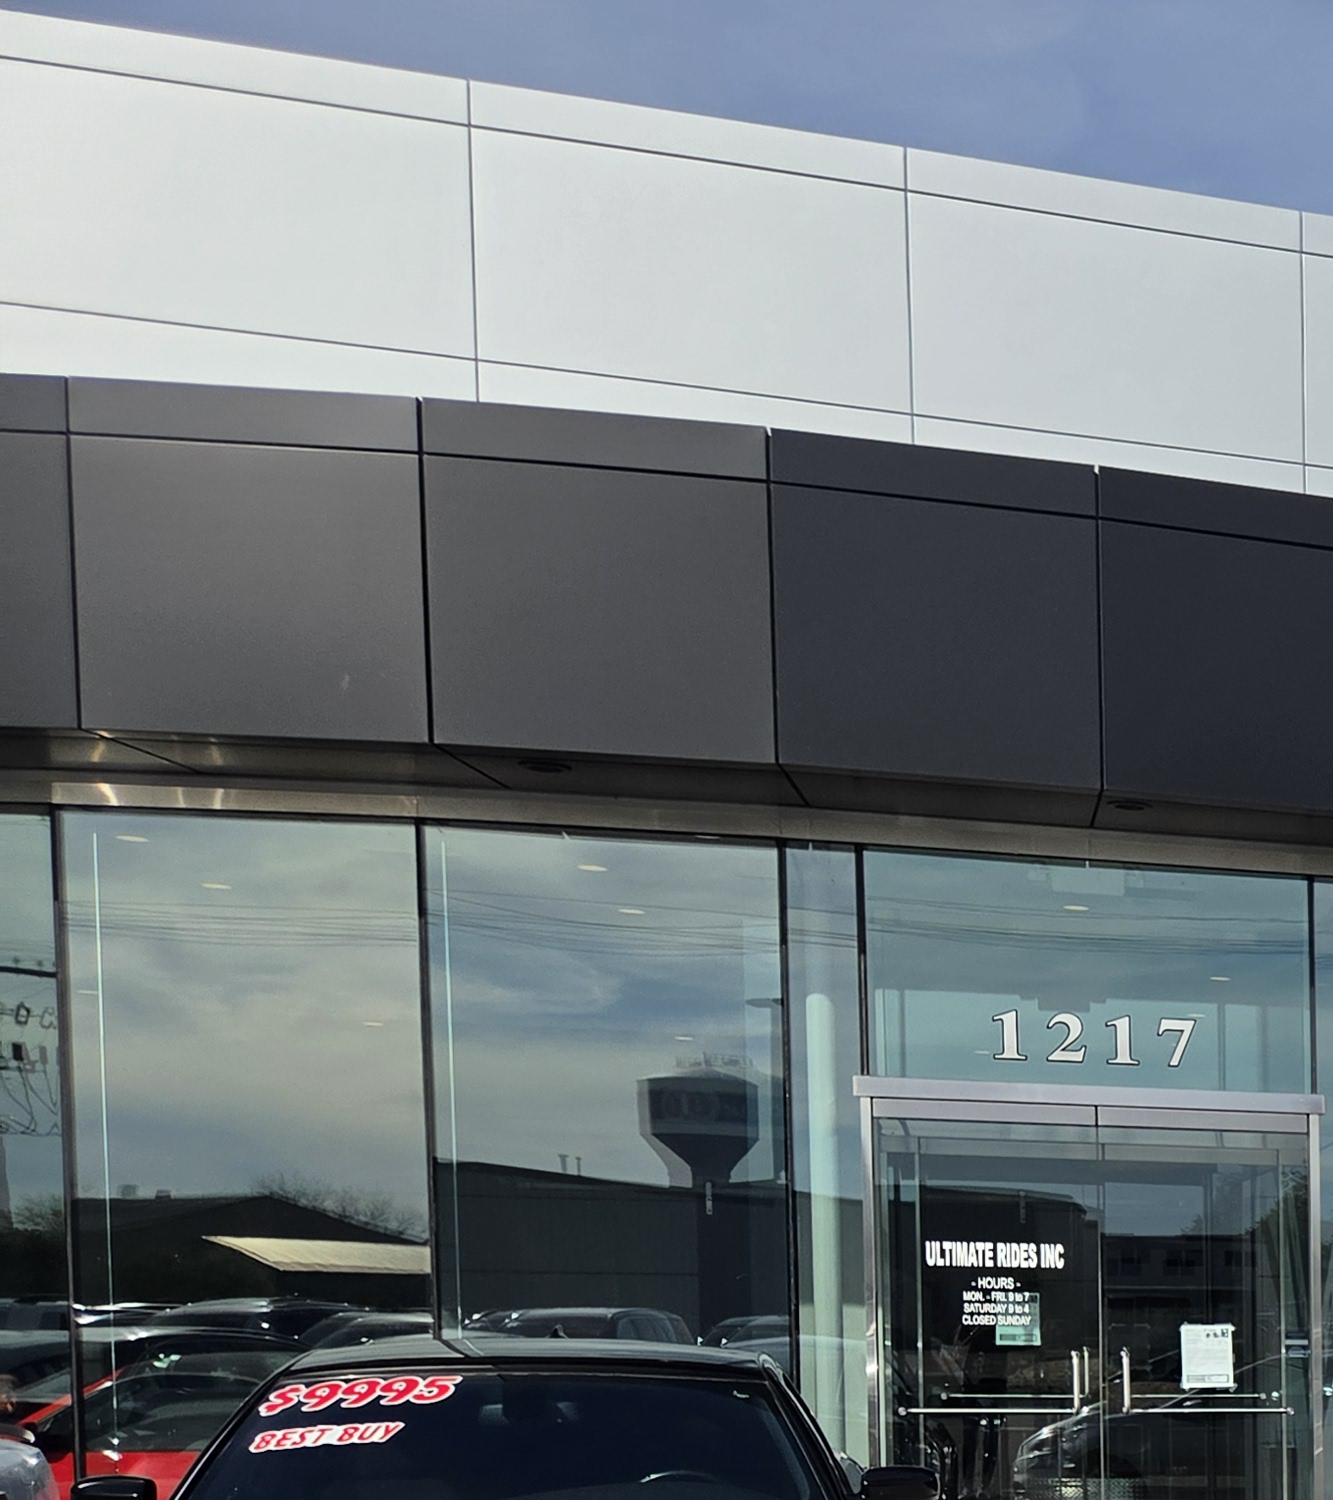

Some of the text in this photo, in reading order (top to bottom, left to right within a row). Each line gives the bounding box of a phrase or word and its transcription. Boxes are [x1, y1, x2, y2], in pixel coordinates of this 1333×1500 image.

[991, 1008, 1198, 1068] 1217
[925, 1241, 1065, 1269] ULTIMATE RIDES INC
[978, 1277, 1014, 1289] HOURS
[962, 1291, 985, 1302] MON.
[1024, 1292, 1030, 1302] 7
[963, 1303, 1007, 1314] SATURDAY
[1023, 1304, 1029, 1314] 4
[962, 1315, 1032, 1326] CLOSED SUNDAY
[258, 1376, 463, 1417] $9995
[250, 1421, 405, 1453] BEST BUY
